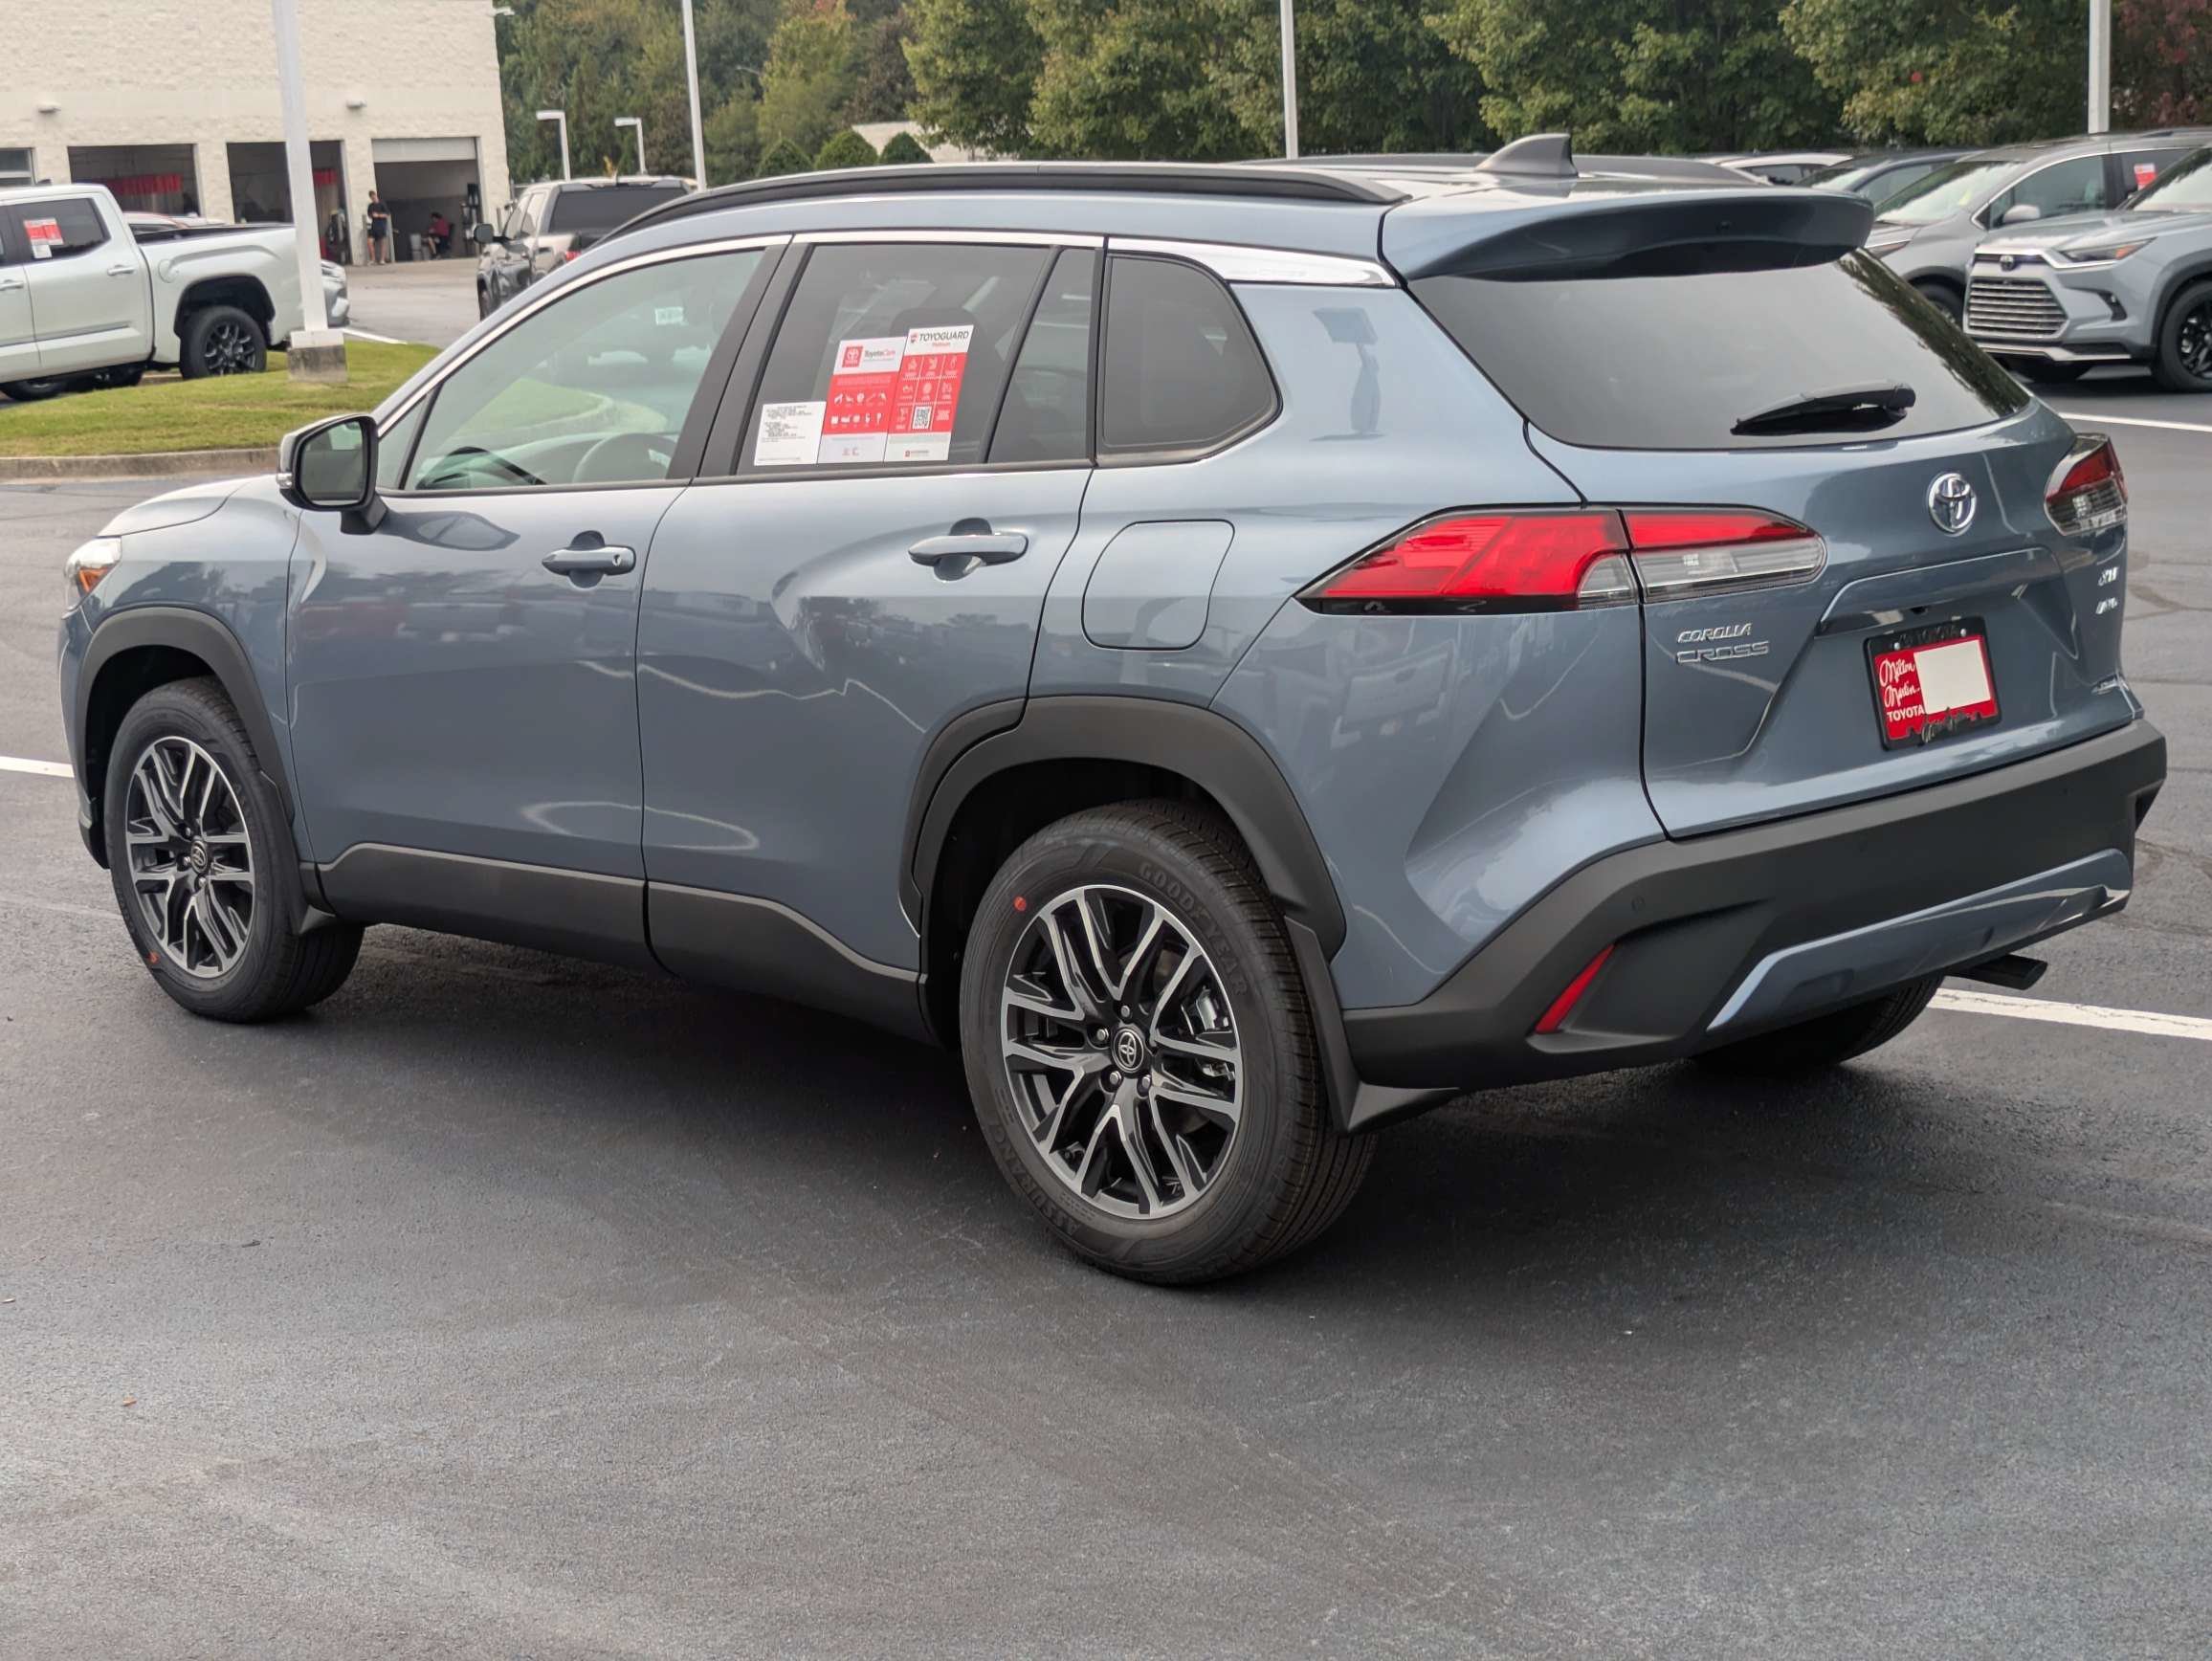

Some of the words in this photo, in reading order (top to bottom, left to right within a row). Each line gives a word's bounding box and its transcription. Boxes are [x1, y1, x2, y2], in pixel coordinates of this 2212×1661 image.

[919, 330, 969, 342] TOYOGUARD
[1677, 623, 1752, 643] COROLLA
[1676, 640, 1769, 663] CROSS
[1887, 704, 1925, 722] TOYOTA
